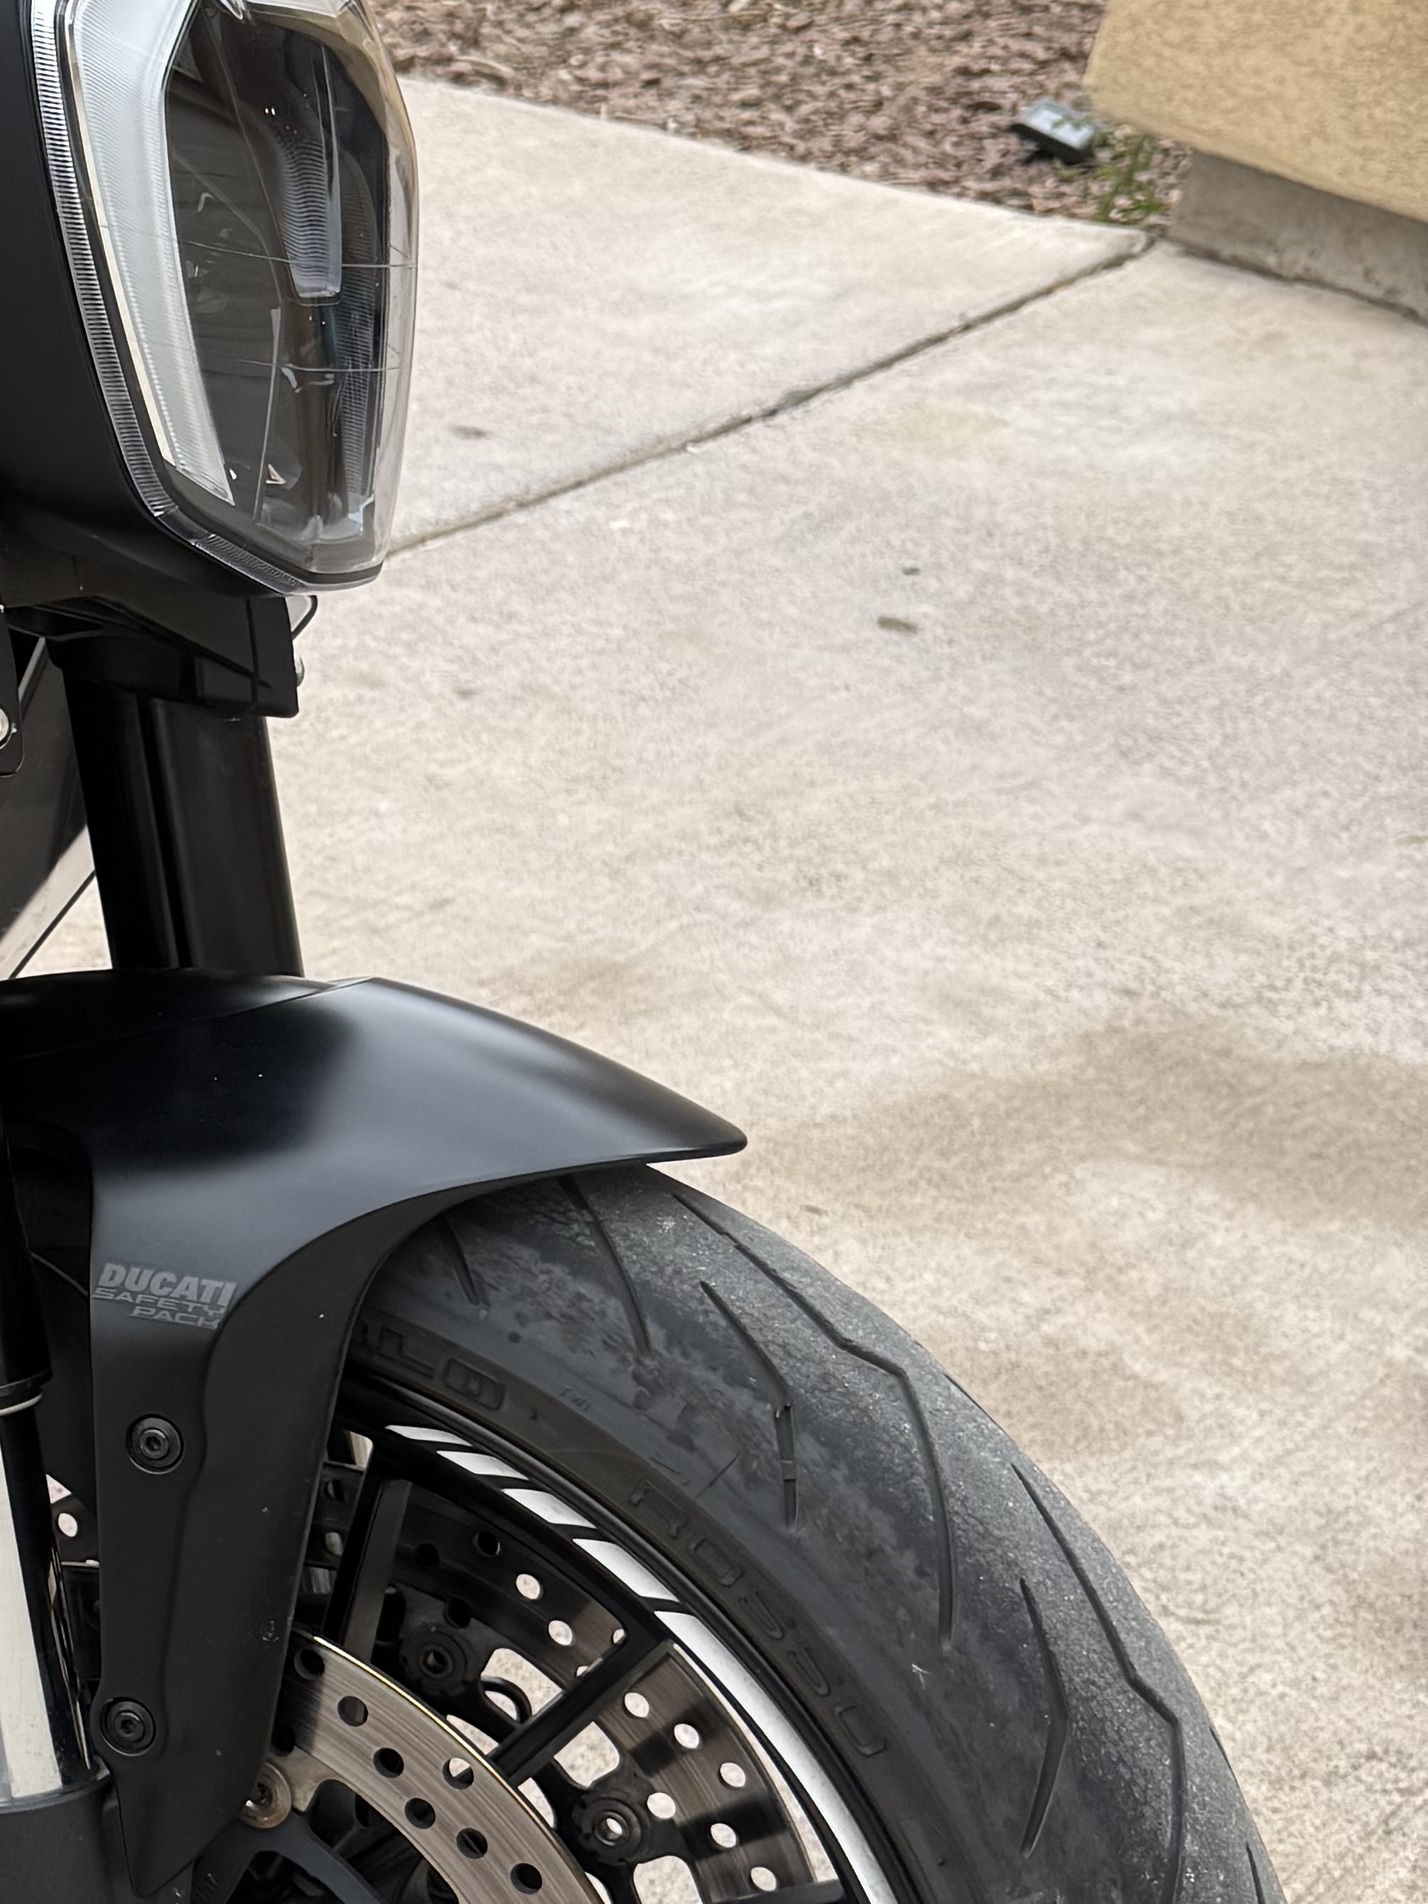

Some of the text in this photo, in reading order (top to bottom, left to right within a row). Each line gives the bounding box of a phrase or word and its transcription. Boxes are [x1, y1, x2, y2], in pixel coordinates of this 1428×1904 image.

[100, 1262, 237, 1309] DUCATI
[93, 1287, 225, 1317] SAFETY
[128, 1305, 224, 1331] PACK
